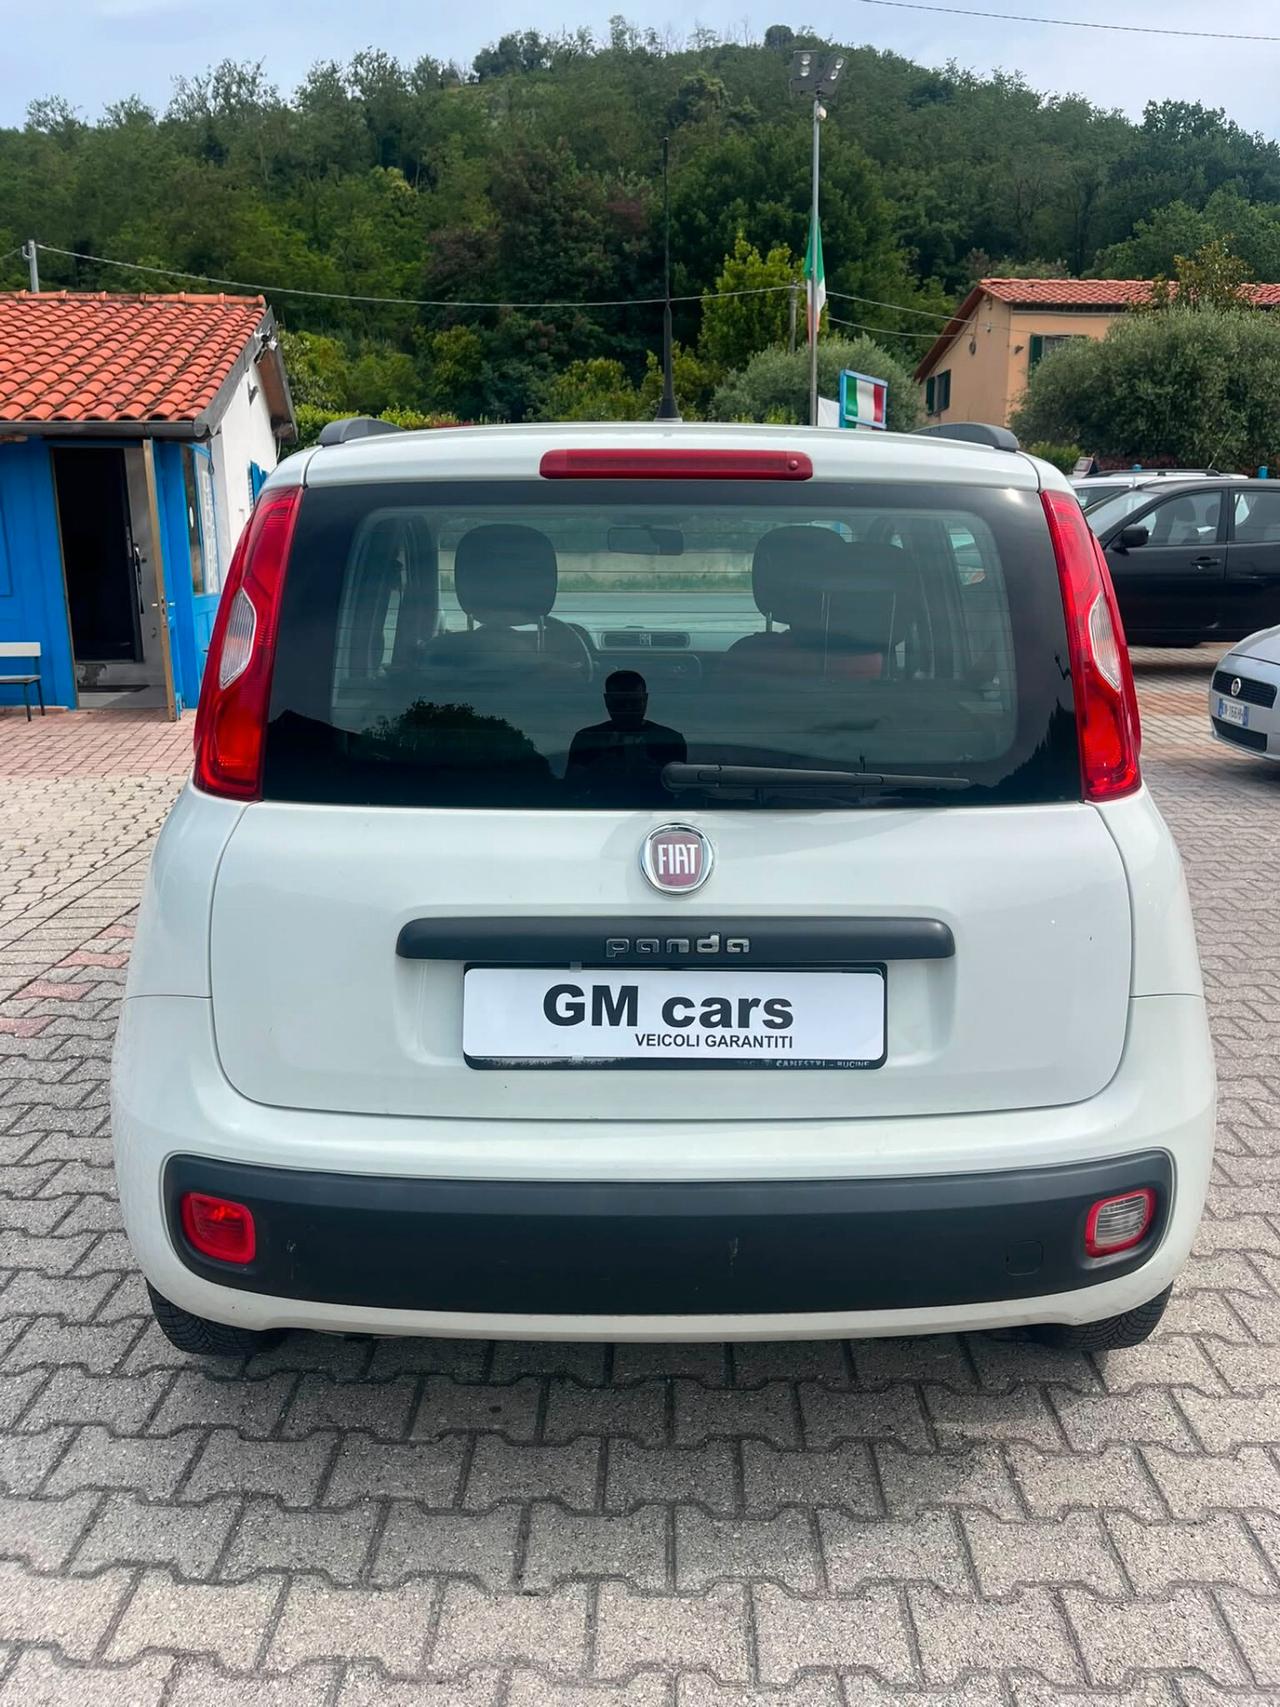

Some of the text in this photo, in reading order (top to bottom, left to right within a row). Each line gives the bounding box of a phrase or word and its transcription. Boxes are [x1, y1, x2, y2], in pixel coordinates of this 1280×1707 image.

[658, 844, 699, 875] FIAT
[606, 933, 750, 958] panda
[544, 984, 793, 1029] GM cars
[635, 1034, 792, 1048] VEICOLI GARANTITI
